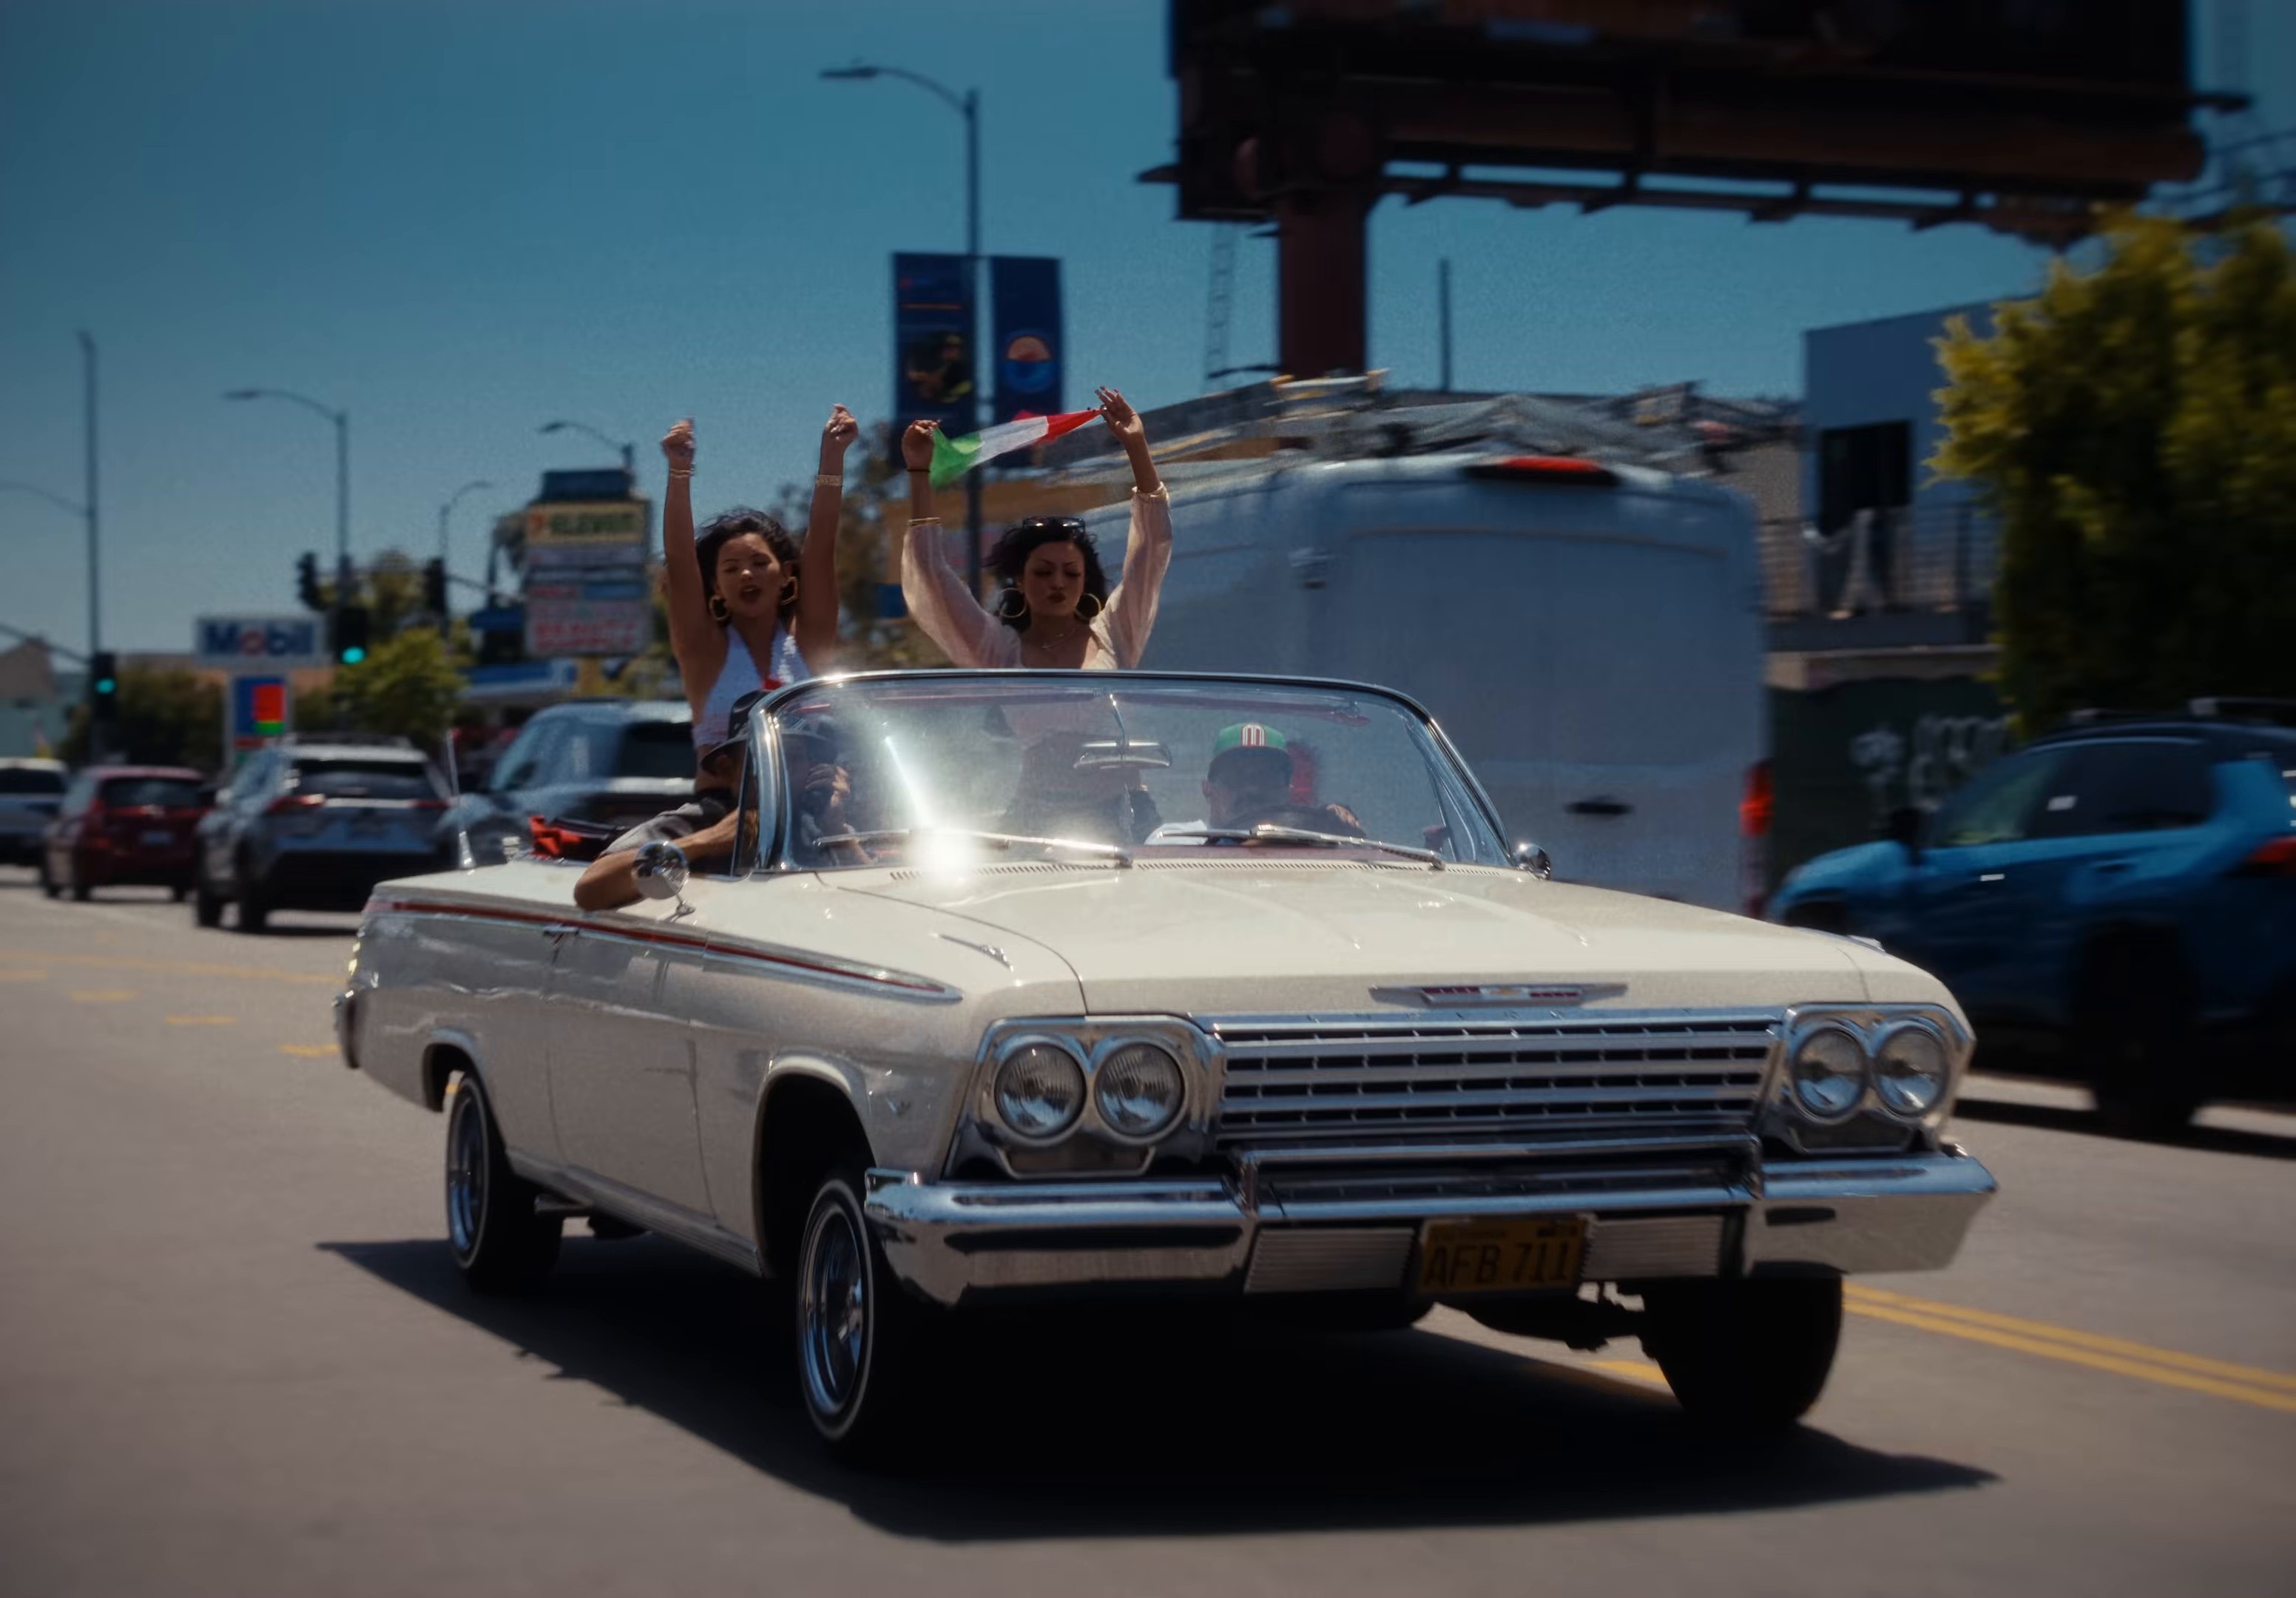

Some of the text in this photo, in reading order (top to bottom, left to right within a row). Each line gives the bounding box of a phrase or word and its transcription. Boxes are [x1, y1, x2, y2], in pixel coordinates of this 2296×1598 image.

[206, 621, 312, 657] Mobil
[1423, 1241, 1570, 1289] AFB 711
